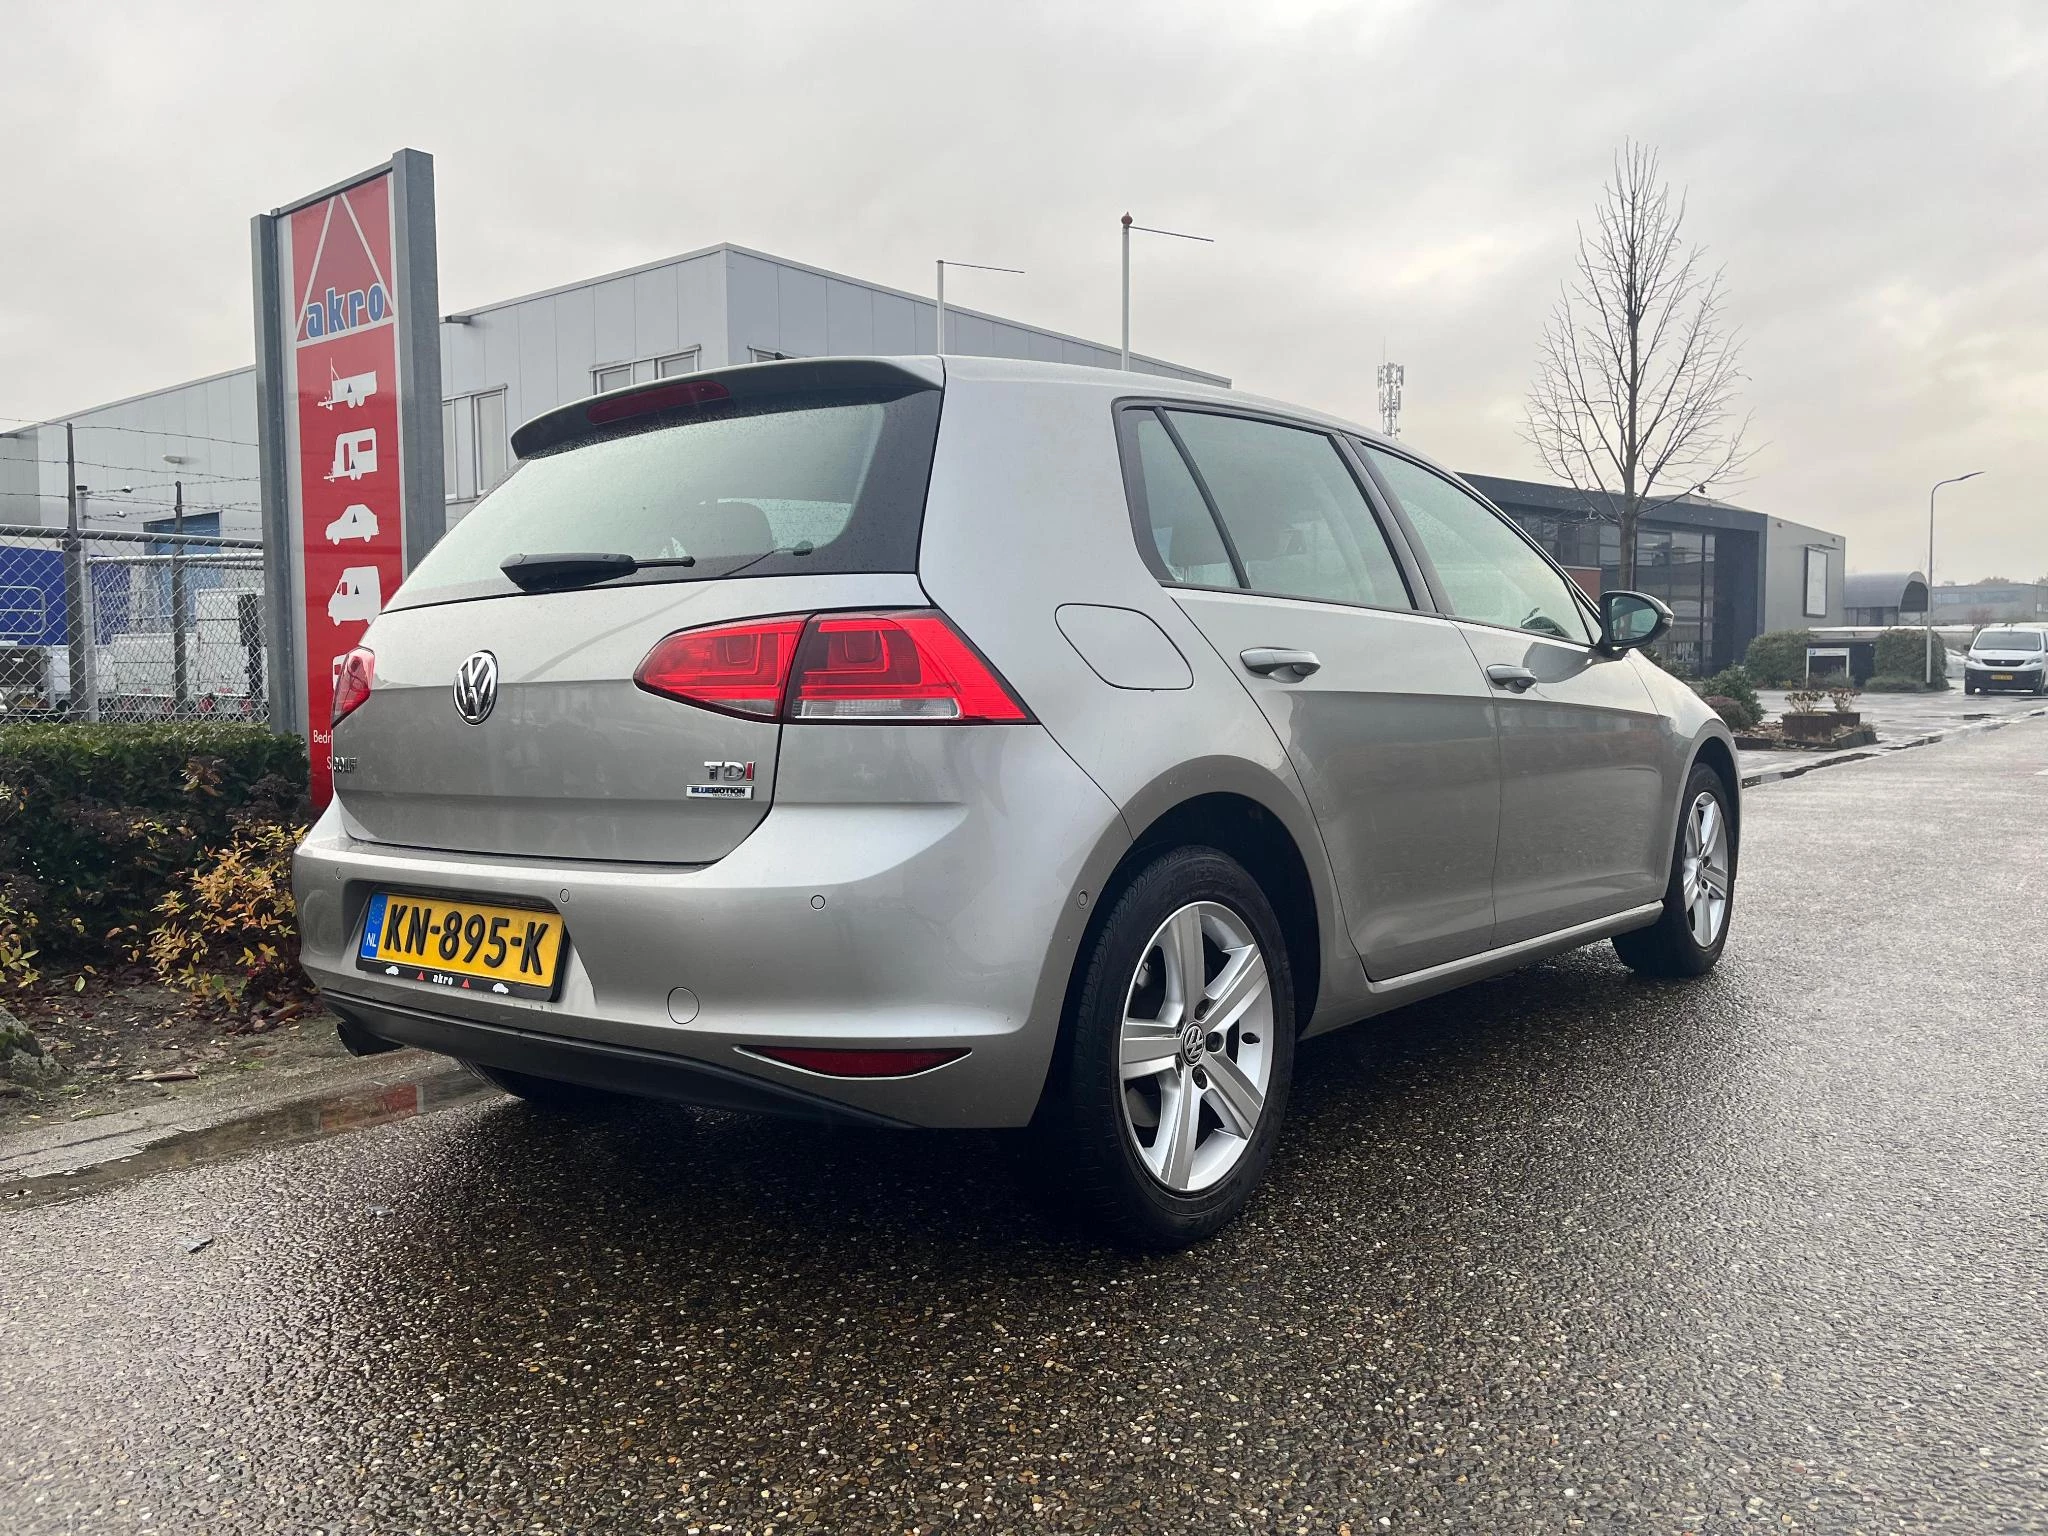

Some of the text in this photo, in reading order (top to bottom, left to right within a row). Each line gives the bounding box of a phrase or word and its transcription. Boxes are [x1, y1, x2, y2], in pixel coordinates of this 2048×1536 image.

[306, 283, 385, 338] akro
[704, 761, 755, 781] TDI
[366, 932, 377, 948] NL
[383, 904, 549, 975] KN-895-K
[432, 973, 453, 986] akro
